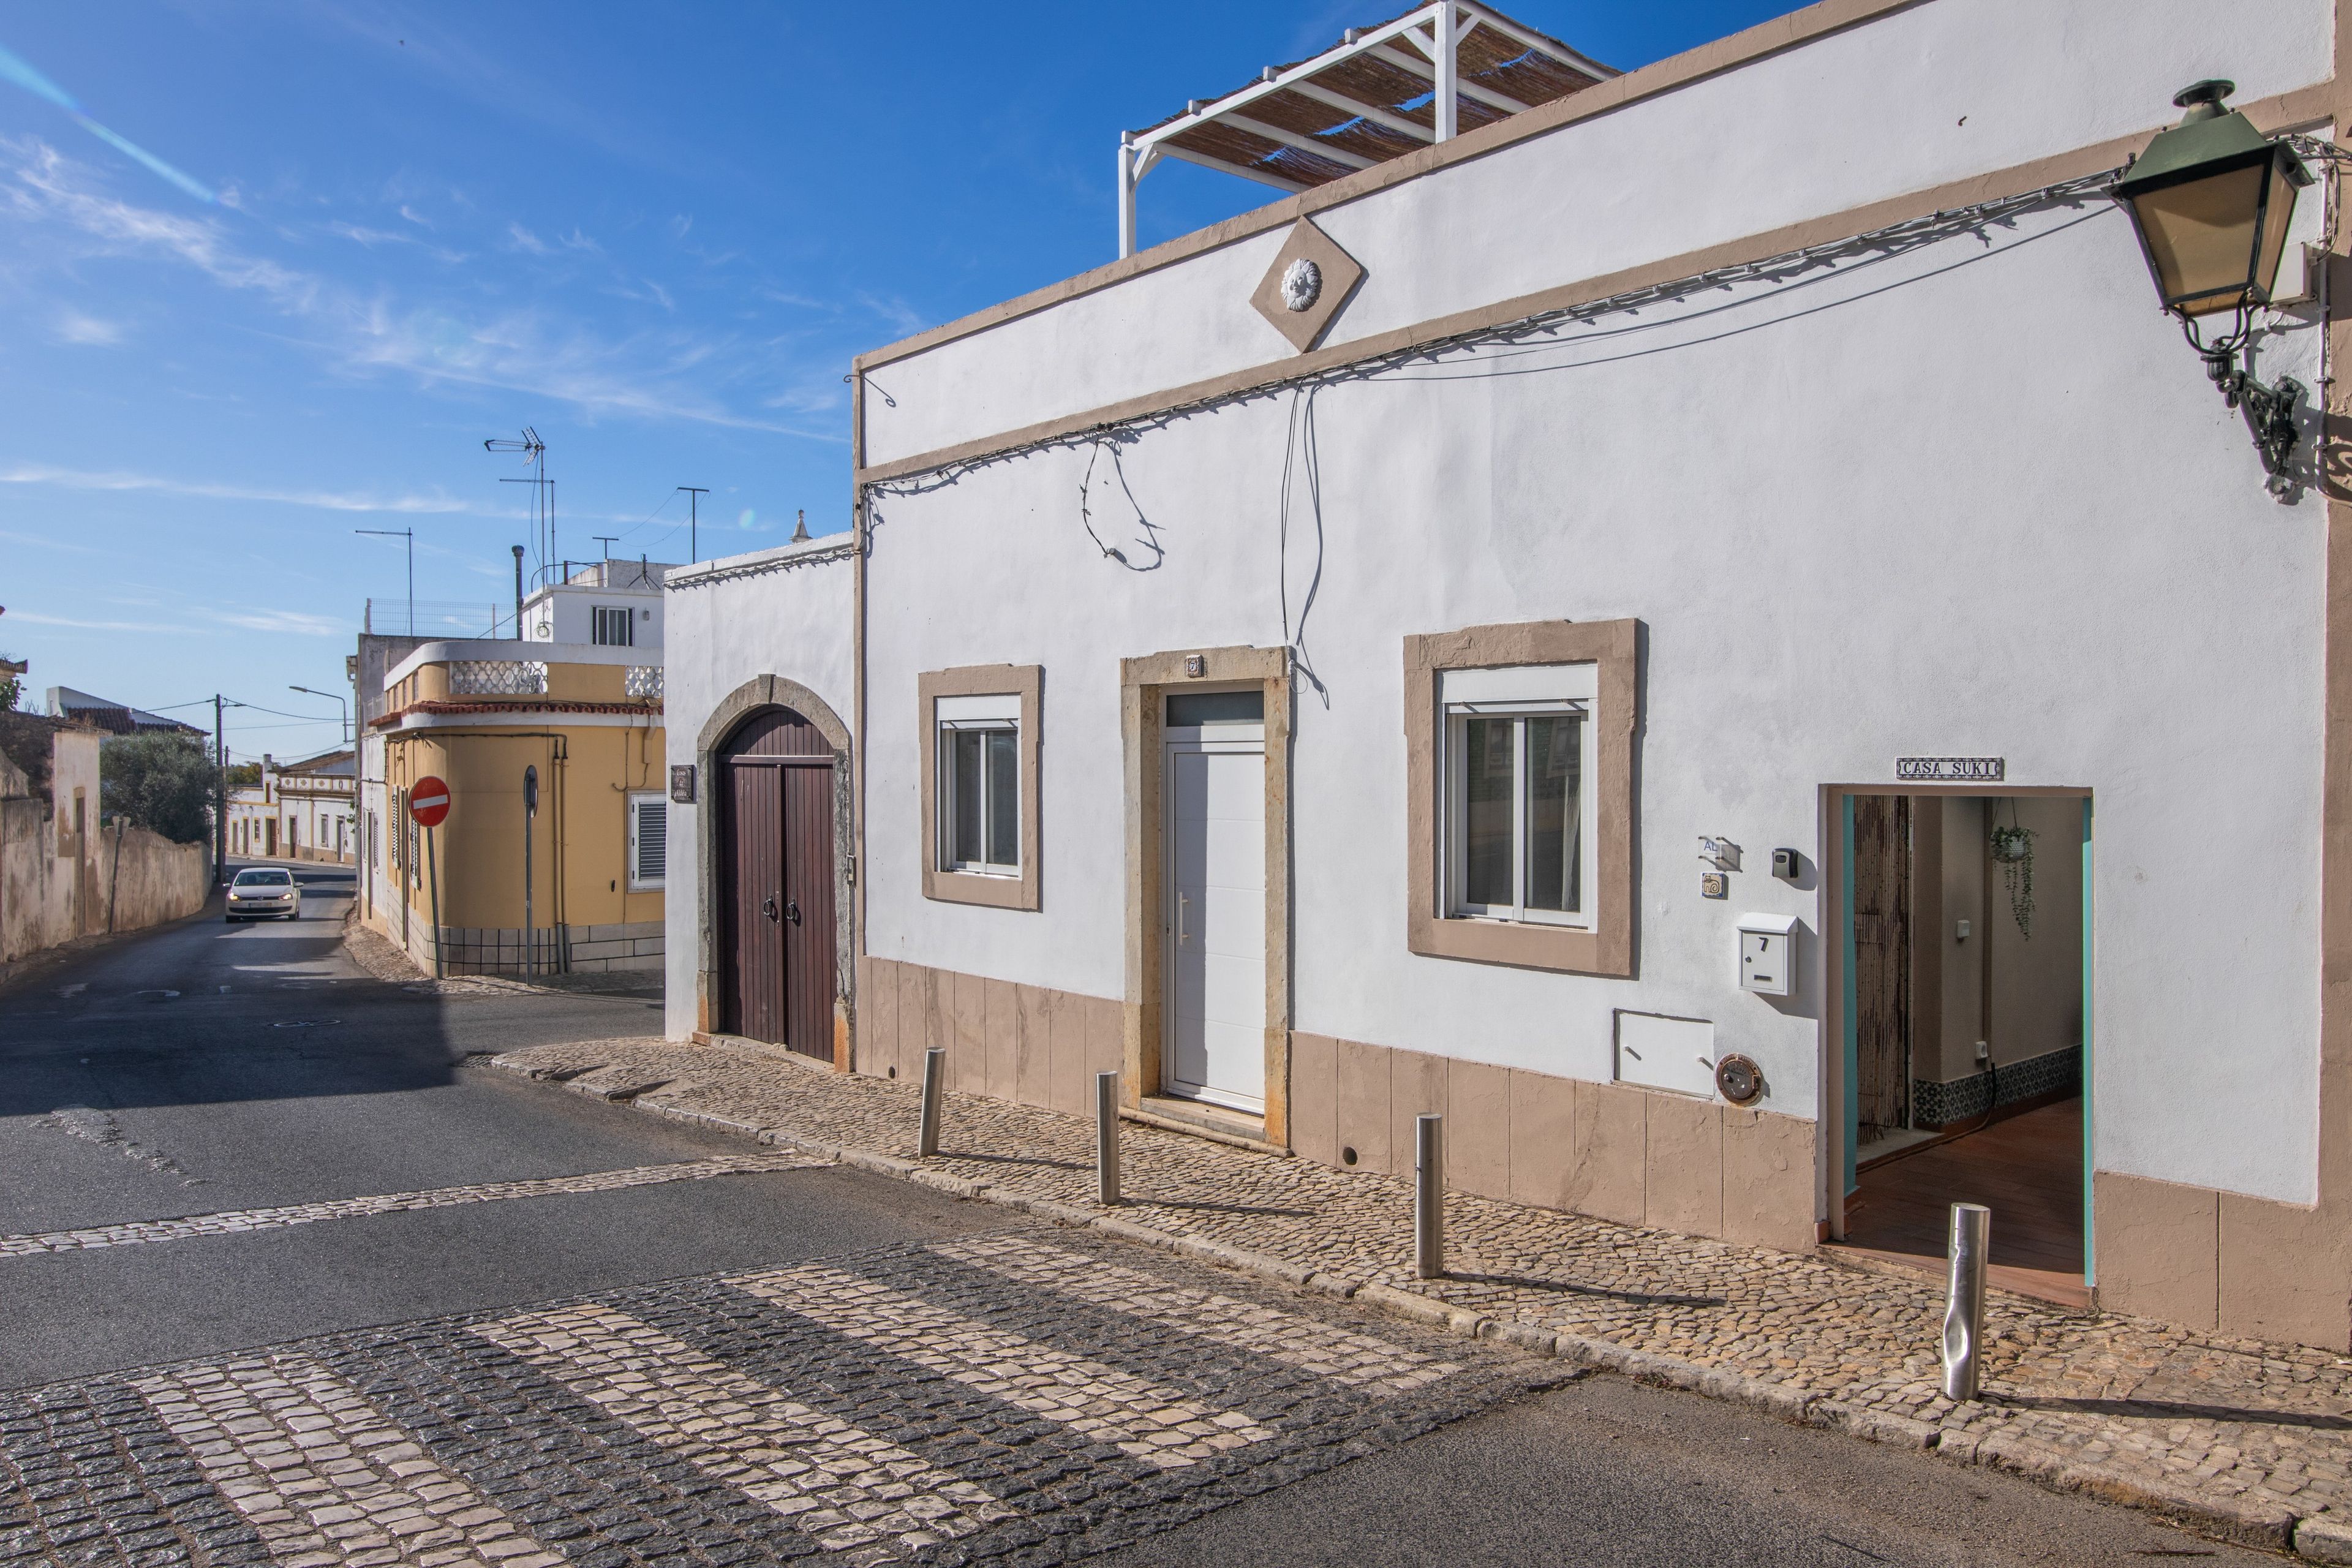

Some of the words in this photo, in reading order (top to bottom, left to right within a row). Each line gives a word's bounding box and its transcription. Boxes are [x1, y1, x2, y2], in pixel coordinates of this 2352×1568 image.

[1903, 761, 1942, 774] CASA
[1952, 762, 1991, 775] SUKI
[1703, 841, 1718, 851] AL
[1758, 937, 1769, 952] 7
